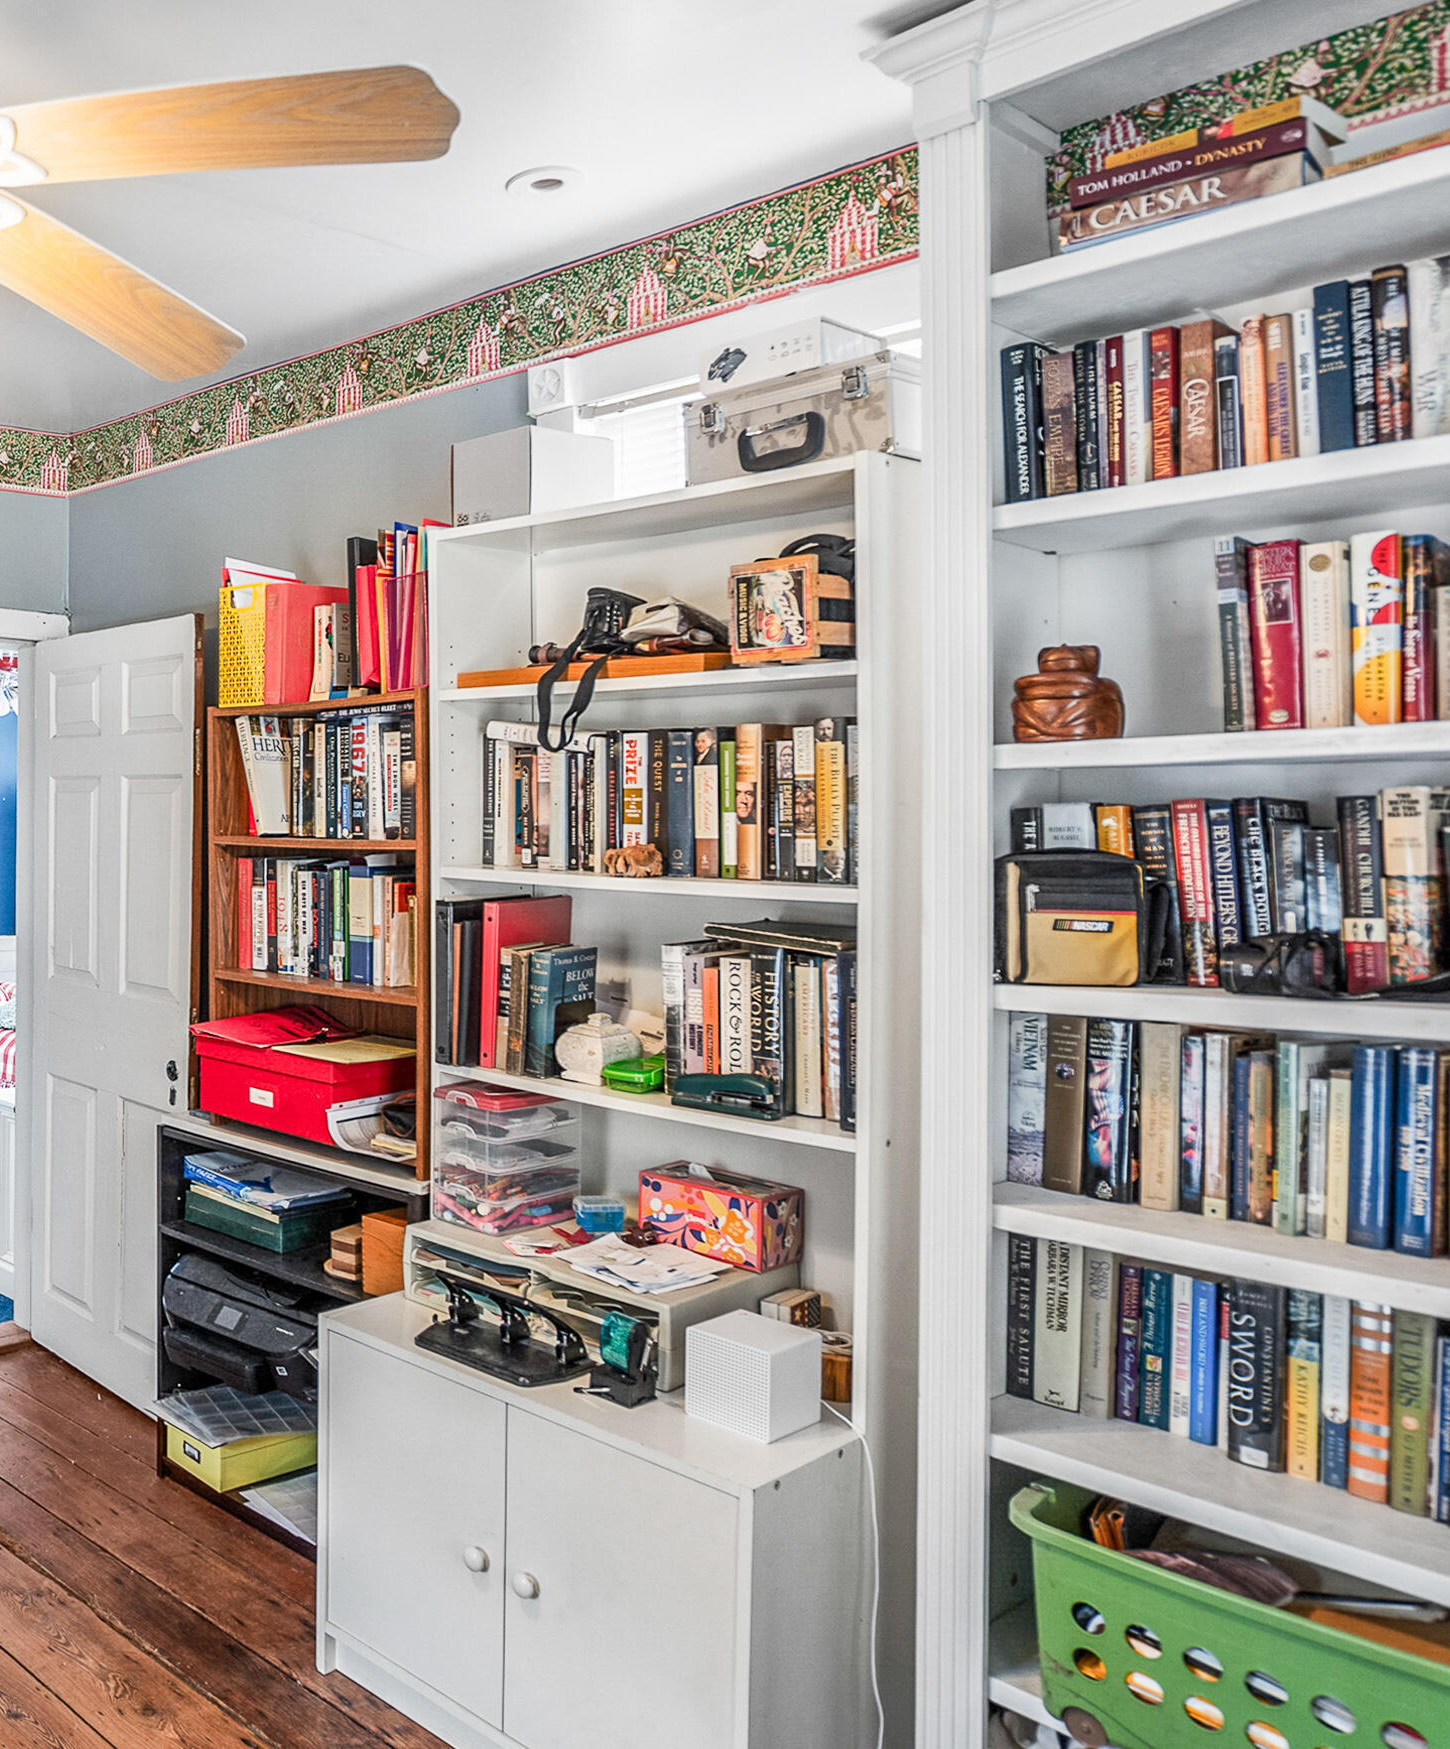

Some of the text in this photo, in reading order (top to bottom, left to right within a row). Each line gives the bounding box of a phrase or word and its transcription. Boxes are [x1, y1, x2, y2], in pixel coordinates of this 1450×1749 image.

[1078, 137, 1266, 197] TOM HOLLAND DYNASTY
[1089, 177, 1227, 230] CAESAR
[1388, 278, 1398, 297] THE
[1076, 349, 1085, 383] BEFORE
[1351, 286, 1373, 405] ATTILA KING OF THE HUNS
[1376, 330, 1391, 403] CHRISTOPHER
[1127, 361, 1138, 381] THE
[1417, 370, 1437, 412] WAR
[1047, 360, 1064, 464] ROMAN EMPIRE
[1182, 379, 1209, 439] CAESAR
[1270, 415, 1279, 438] TIME
[1277, 362, 1290, 454] ALEXANDER THE GREAT
[1014, 376, 1030, 495] THE SEARCH FOR ALEXANDER
[1155, 438, 1170, 477] LEGION
[738, 583, 747, 611] MUSIC
[1367, 567, 1380, 614] GENE
[739, 621, 748, 644] VIDEO
[1405, 630, 1421, 702] Siege Vienna
[351, 723, 365, 773] 1967
[626, 740, 636, 785] PRIZE
[654, 739, 662, 757] THE
[654, 761, 662, 792] QUEST
[830, 747, 840, 840] THE BULLY PULPIT
[782, 785, 792, 821] EMPIRE
[1189, 812, 1198, 827] THE
[1024, 821, 1036, 838] THE
[1177, 813, 1197, 918] FRENCH REVOLUTION
[1193, 860, 1201, 890] HISTORY
[1212, 826, 1236, 925] BEYOND HITLER'S
[1251, 849, 1264, 889] BLACK
[1356, 799, 1374, 916] GANDHI CHURCHILL
[278, 897, 287, 933] 1948
[1197, 904, 1206, 918] THE
[566, 968, 596, 982] BELOW
[578, 982, 589, 992] the
[729, 961, 742, 1012] ROCK
[688, 989, 702, 1025] USSR
[730, 1015, 742, 1034] &
[751, 973, 761, 1052] OF WORLD
[763, 971, 780, 1055] HISTORY
[1022, 1018, 1038, 1071] VIETNAM
[1413, 1084, 1432, 1216] Medieval Civilization
[1056, 1247, 1069, 1332] DISTANT MIRROR
[1089, 1260, 1101, 1300] DARROW
[1099, 1260, 1110, 1301] CLARENCE
[1123, 1277, 1132, 1316] TUCHMAN
[1018, 1241, 1030, 1386] THE FIRST SALUTE
[1046, 1287, 1054, 1330] TUCHMAN
[1198, 1320, 1206, 1337] AND
[1198, 1338, 1206, 1366] SWORD
[1230, 1311, 1257, 1427] SWORD
[1397, 1328, 1424, 1409] TUDORS
[1261, 1326, 1274, 1424] CONSTANTINE'S
[1296, 1364, 1310, 1458] KATHY REICHS
